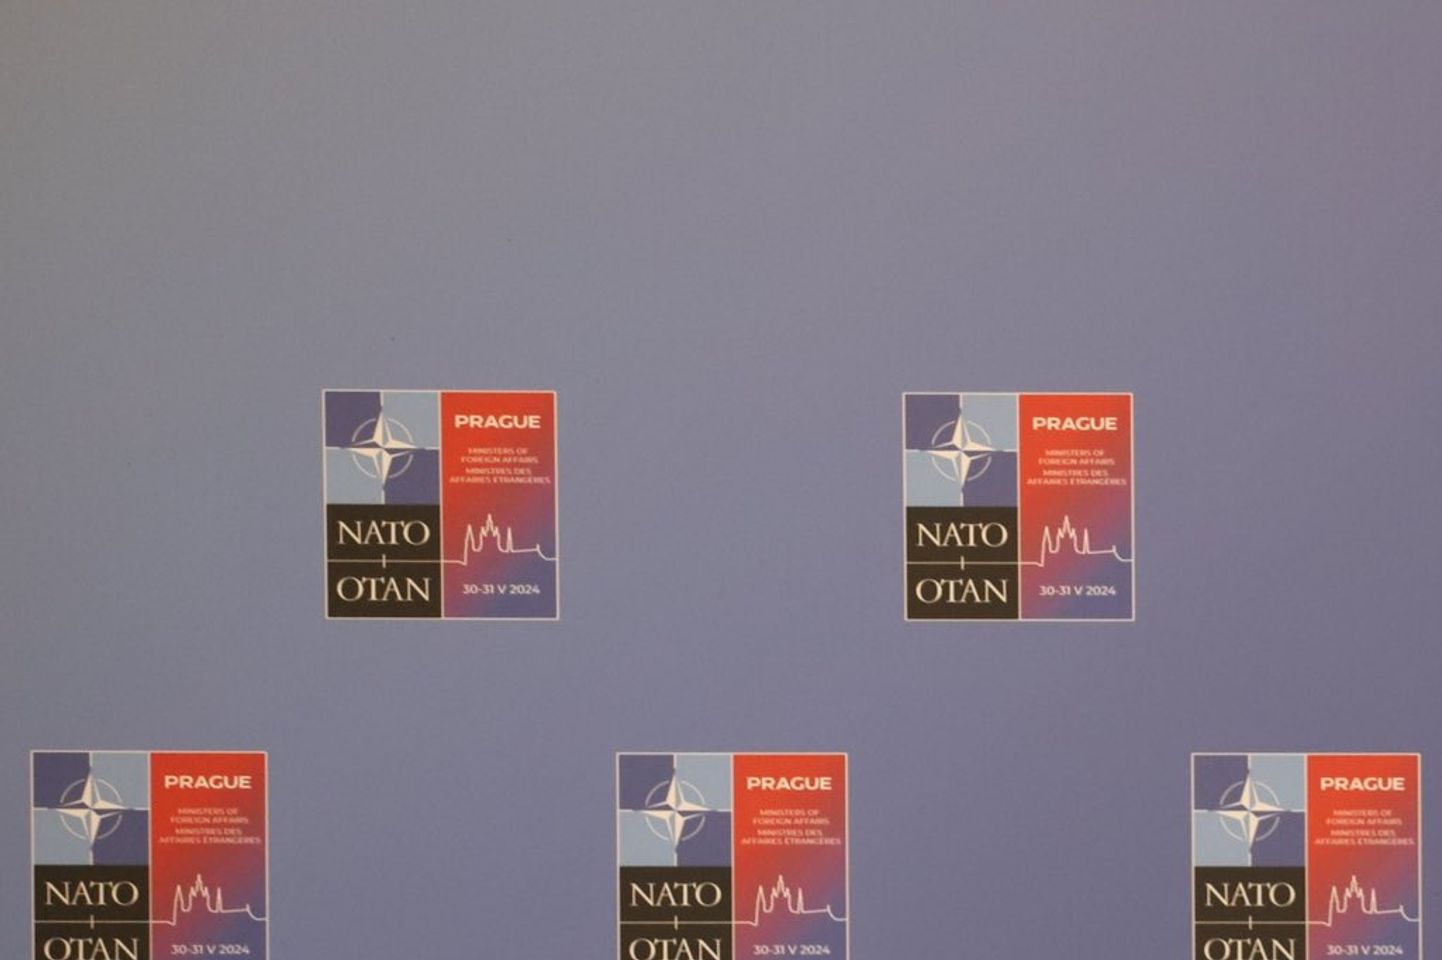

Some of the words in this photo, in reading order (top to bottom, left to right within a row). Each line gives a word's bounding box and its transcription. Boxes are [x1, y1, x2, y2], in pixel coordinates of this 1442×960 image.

[454, 414, 541, 429] PRAGUE
[1032, 417, 1118, 430] PRAGUE
[336, 519, 430, 545] NATO
[916, 522, 1008, 547] NATO
[336, 576, 431, 602] OTAN
[462, 584, 494, 594] 30-31
[496, 584, 507, 594] V
[509, 584, 540, 594] 2024
[915, 578, 1009, 603] OTAN
[1039, 585, 1071, 595] 30-31
[1073, 585, 1083, 595] V
[1085, 586, 1116, 595] 2024
[164, 775, 252, 789] PRAGUE
[746, 776, 832, 790] PRAGUE
[1320, 777, 1405, 791] PRAGUE
[44, 880, 139, 905] NATO
[629, 882, 722, 906] NATO
[1204, 882, 1295, 906] NATO
[171, 944, 203, 954] 30-31
[205, 944, 216, 954] V
[218, 944, 250, 954] 2024
[753, 945, 785, 955] 30-31
[787, 945, 797, 955] V
[799, 945, 830, 955] 2024
[1326, 945, 1358, 955] 30-31
[1360, 945, 1370, 955] V
[1372, 945, 1403, 955] 2024
